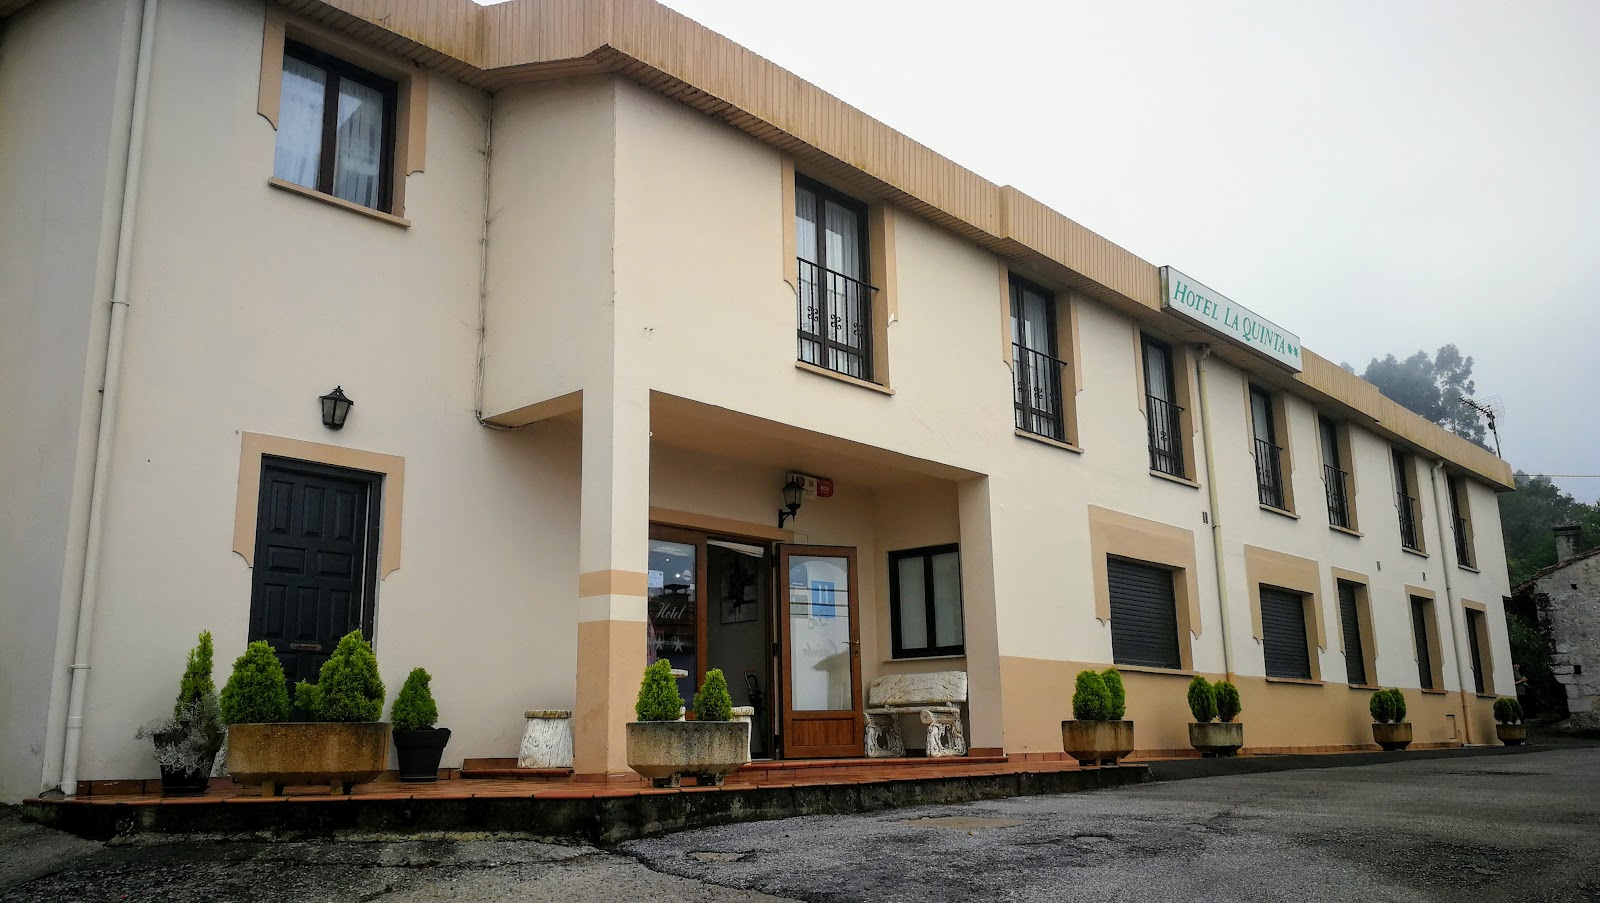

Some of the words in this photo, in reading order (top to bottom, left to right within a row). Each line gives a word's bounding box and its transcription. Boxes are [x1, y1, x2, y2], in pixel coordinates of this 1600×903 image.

[1173, 280, 1218, 321] HOTEL
[1223, 307, 1239, 332] LA
[1242, 316, 1286, 355] QUINTA
[656, 602, 687, 620] Hotel
